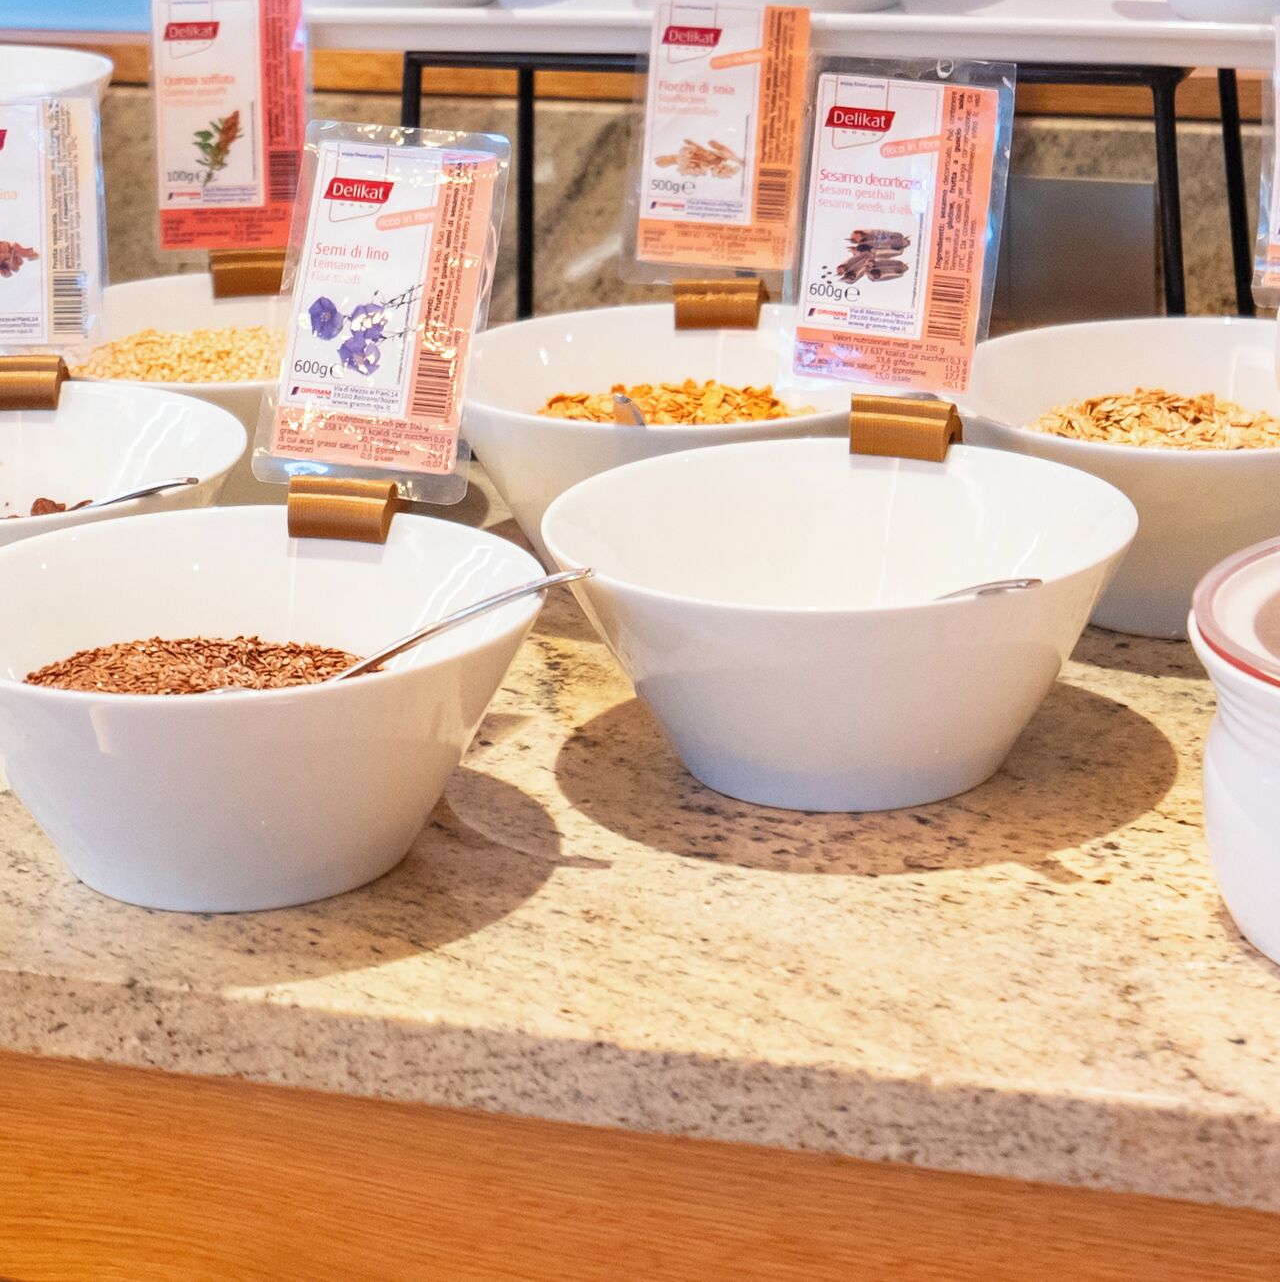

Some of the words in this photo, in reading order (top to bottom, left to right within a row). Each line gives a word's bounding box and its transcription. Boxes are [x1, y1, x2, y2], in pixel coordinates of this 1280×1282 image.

[169, 25, 213, 38] Delikat
[669, 29, 714, 44] Delikat
[658, 80, 695, 93] Fiocchi
[699, 81, 709, 94] di
[833, 110, 886, 128] Delikat
[167, 171, 194, 183] 100g
[820, 169, 863, 184] Sesamo
[332, 182, 384, 200] Delikat
[650, 179, 680, 194] 500g
[819, 184, 852, 196] Sesam
[315, 242, 346, 257] Semi
[351, 245, 362, 258] di
[366, 246, 389, 261] lino
[809, 283, 842, 301] 600g
[926, 344, 939, 352] 100
[294, 359, 328, 379] 600g
